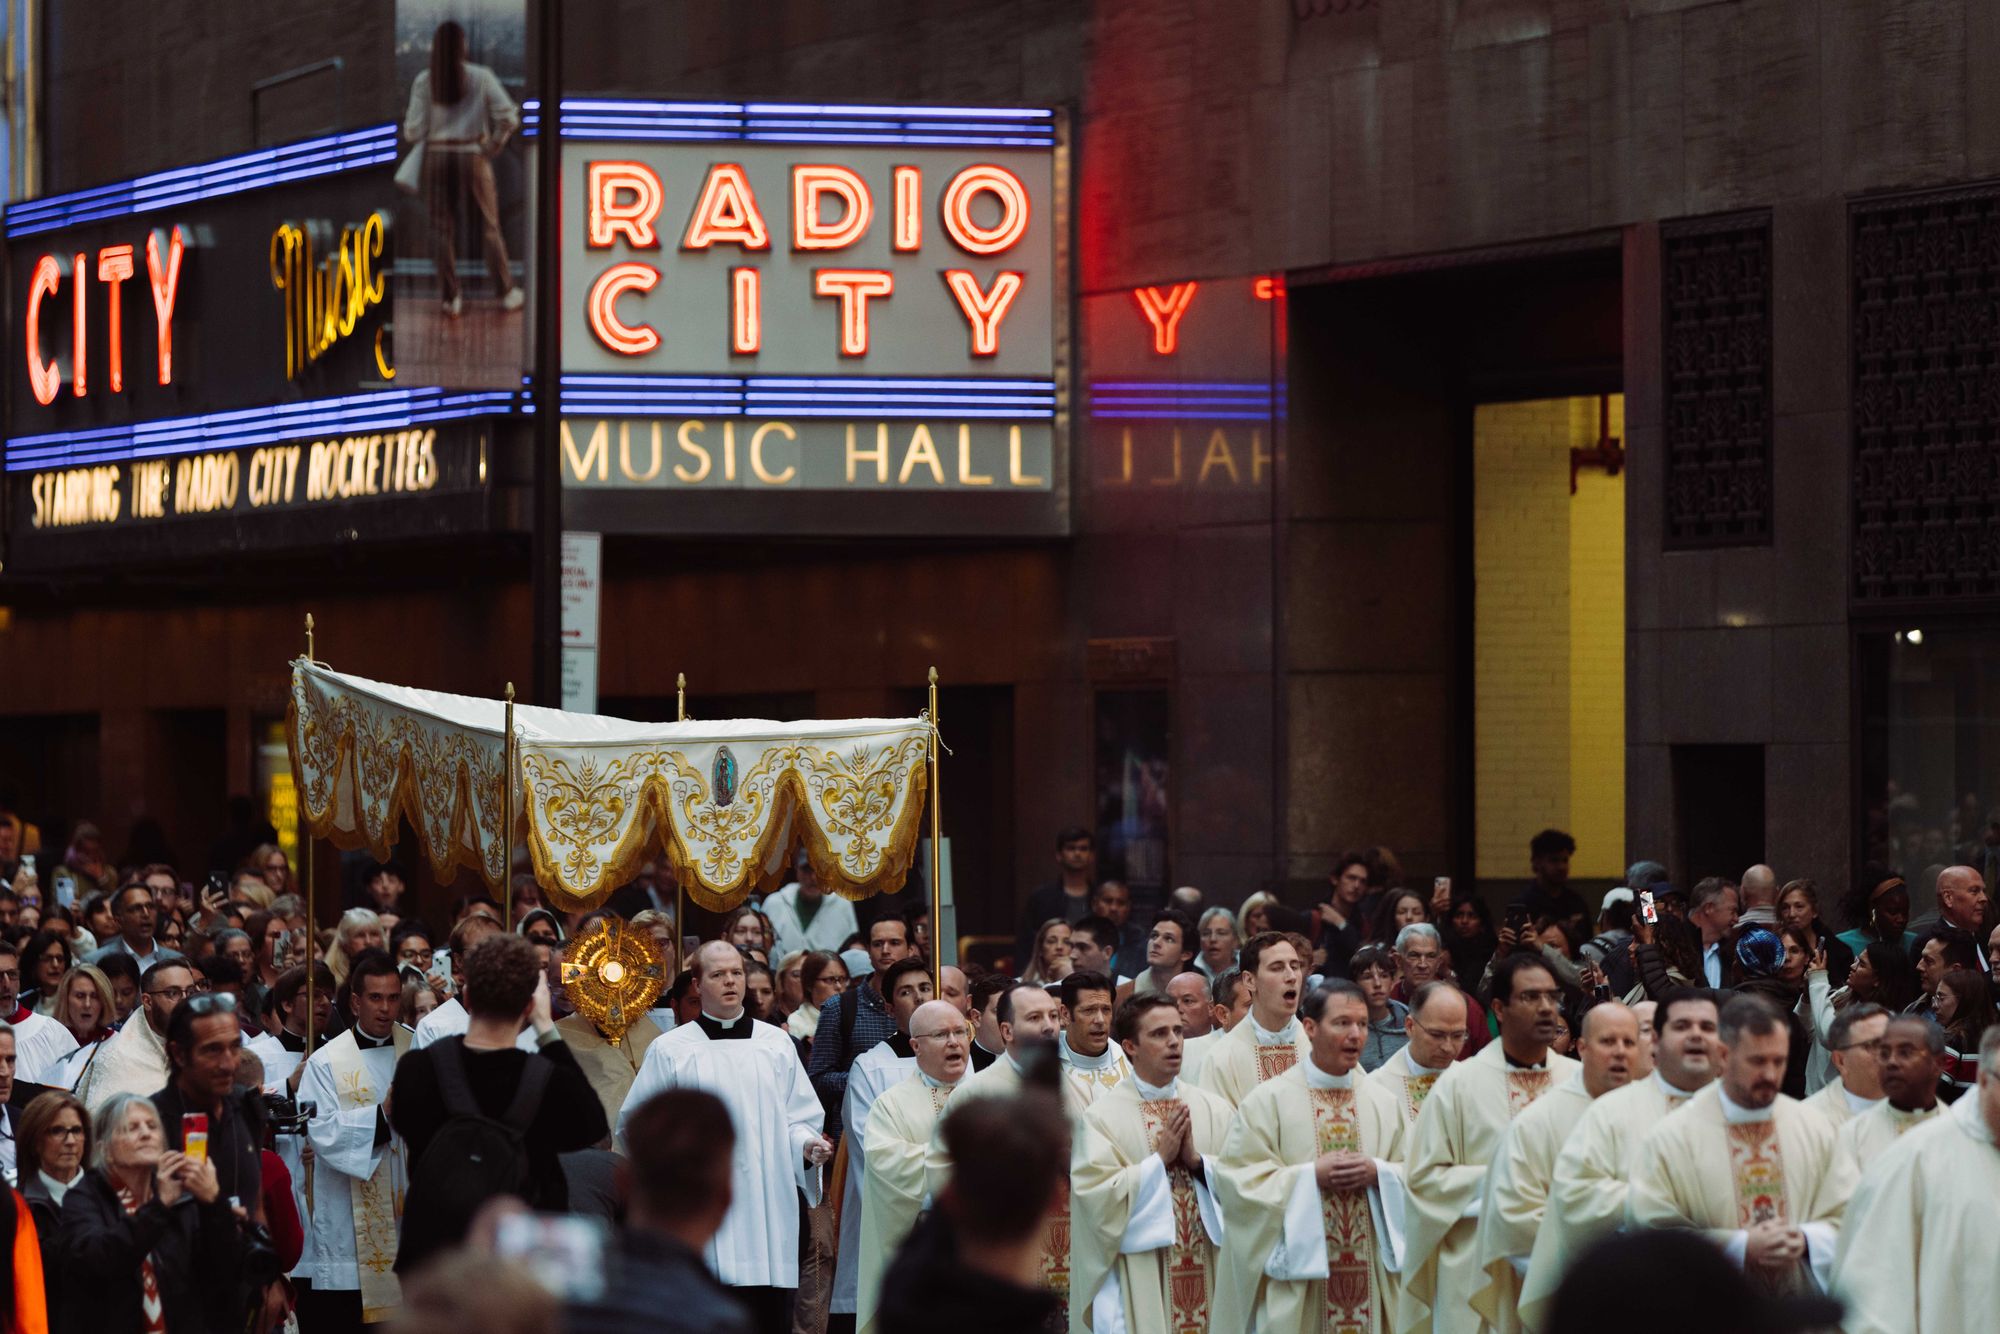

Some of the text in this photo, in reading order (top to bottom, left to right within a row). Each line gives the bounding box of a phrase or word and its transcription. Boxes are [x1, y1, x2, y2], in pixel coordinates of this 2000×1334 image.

[587, 160, 1031, 256] RADIO
[26, 225, 185, 406] CITY
[587, 262, 1024, 356] CITY
[31, 428, 437, 529] STARRING THE RADIO CITY ROCKETTES
[559, 420, 1043, 486] MUSIC HALL
